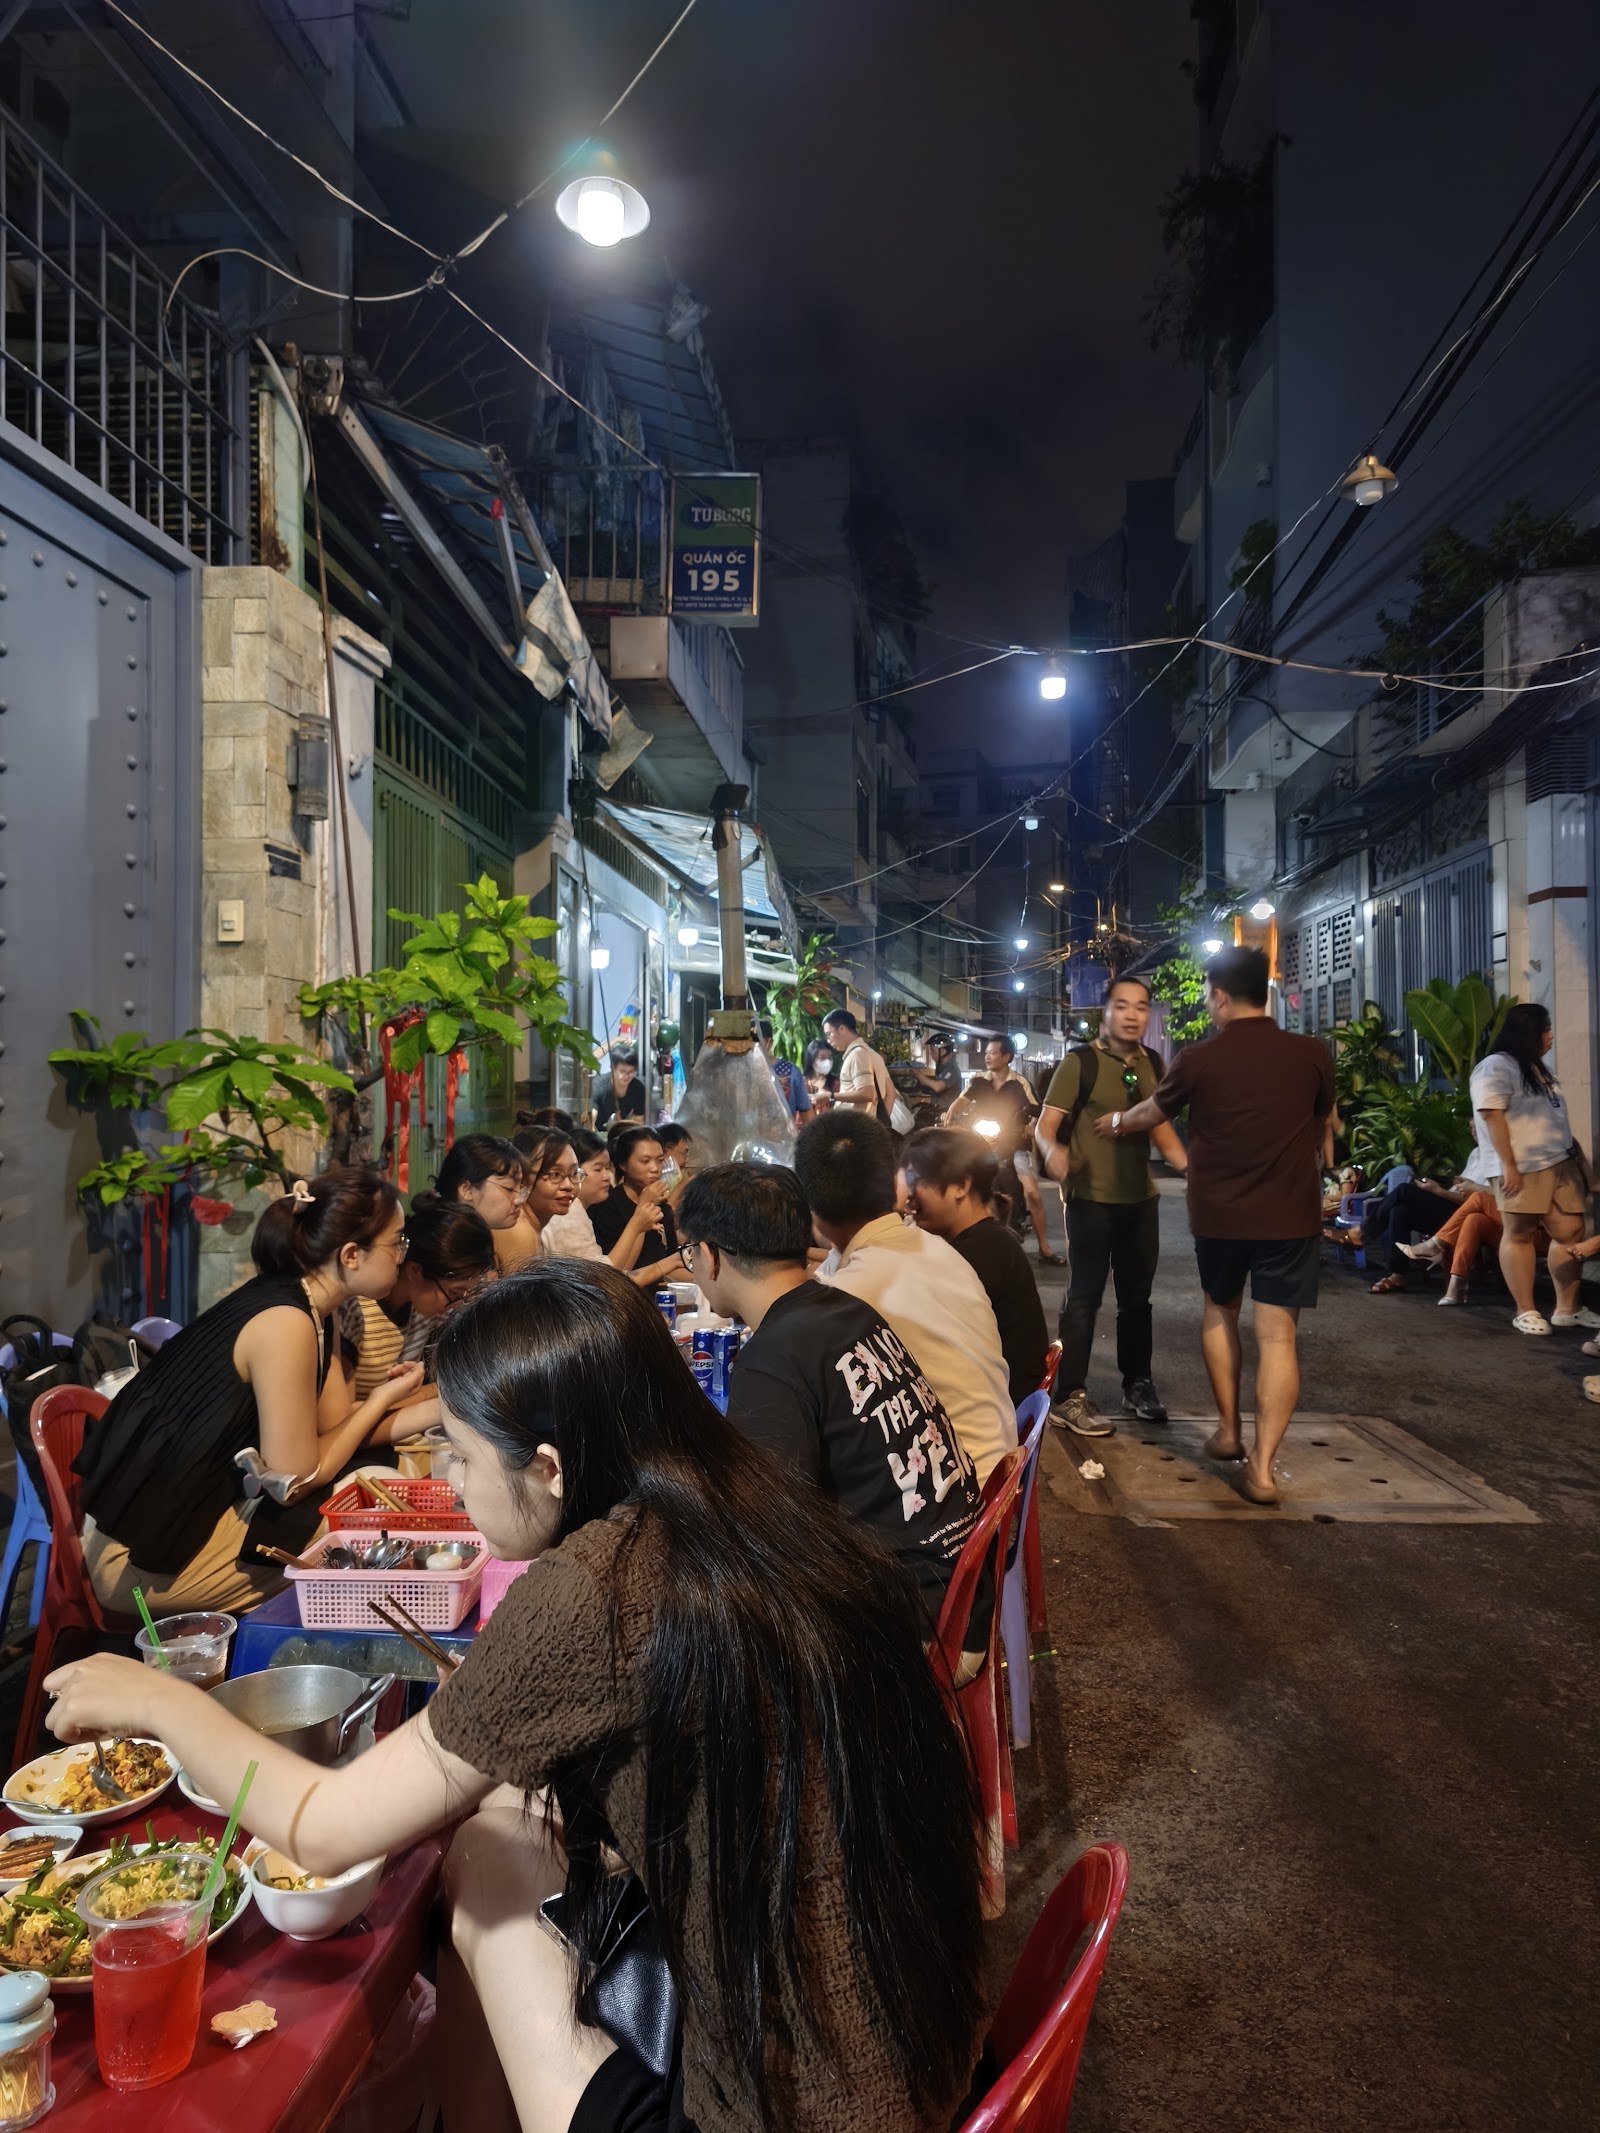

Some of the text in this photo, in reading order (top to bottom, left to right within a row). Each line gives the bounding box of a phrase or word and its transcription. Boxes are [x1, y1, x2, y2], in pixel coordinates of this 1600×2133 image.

[691, 507, 751, 523] TUBORG
[683, 550, 746, 566] QUÁN ỐC
[688, 570, 740, 592] 195
[835, 1328, 918, 1415] ENJO
[871, 1389, 918, 1444] THE
